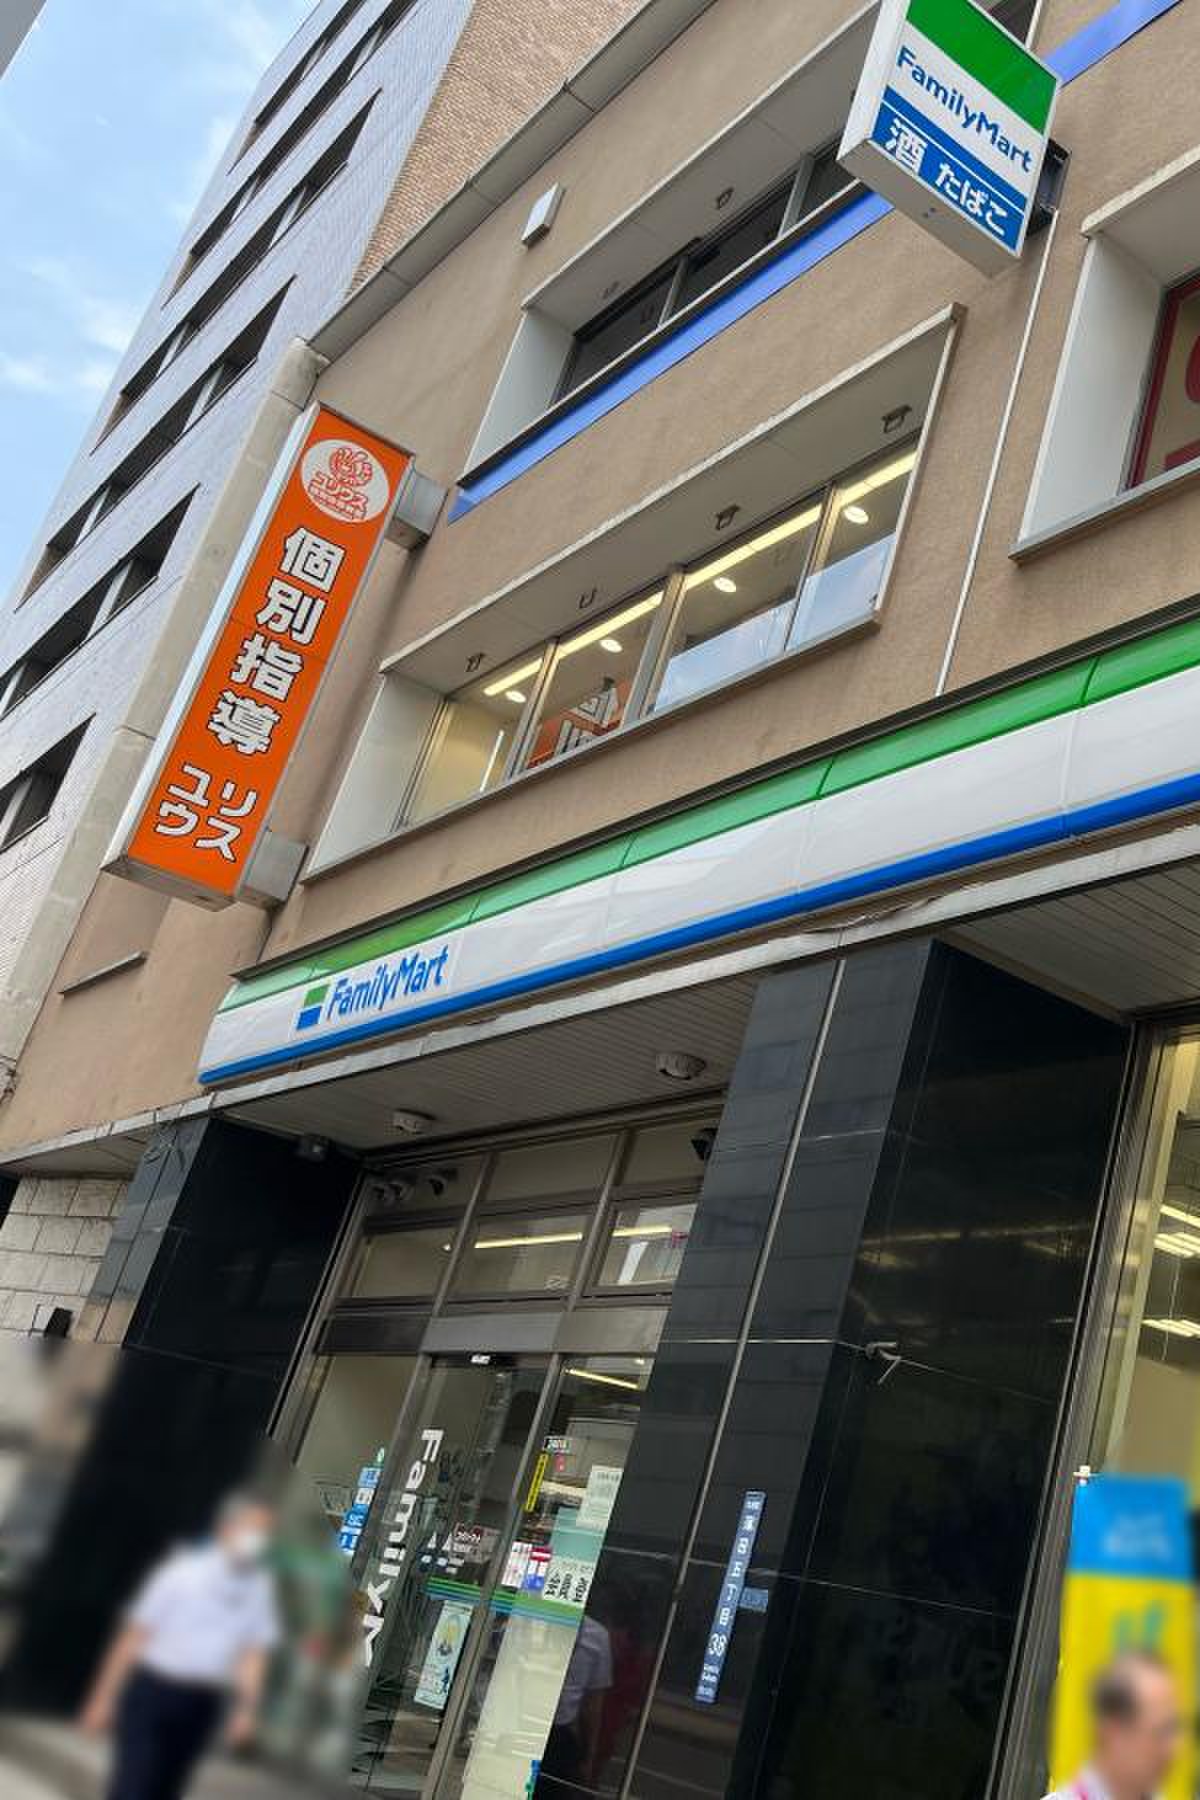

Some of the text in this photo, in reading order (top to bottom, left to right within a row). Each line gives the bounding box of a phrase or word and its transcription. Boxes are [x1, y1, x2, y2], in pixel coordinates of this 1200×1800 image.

[896, 45, 1033, 173] FamilyMart
[885, 117, 1008, 237] 酒 たばこ
[207, 527, 345, 755] 個別指導
[327, 944, 449, 1020] FamilyMart
